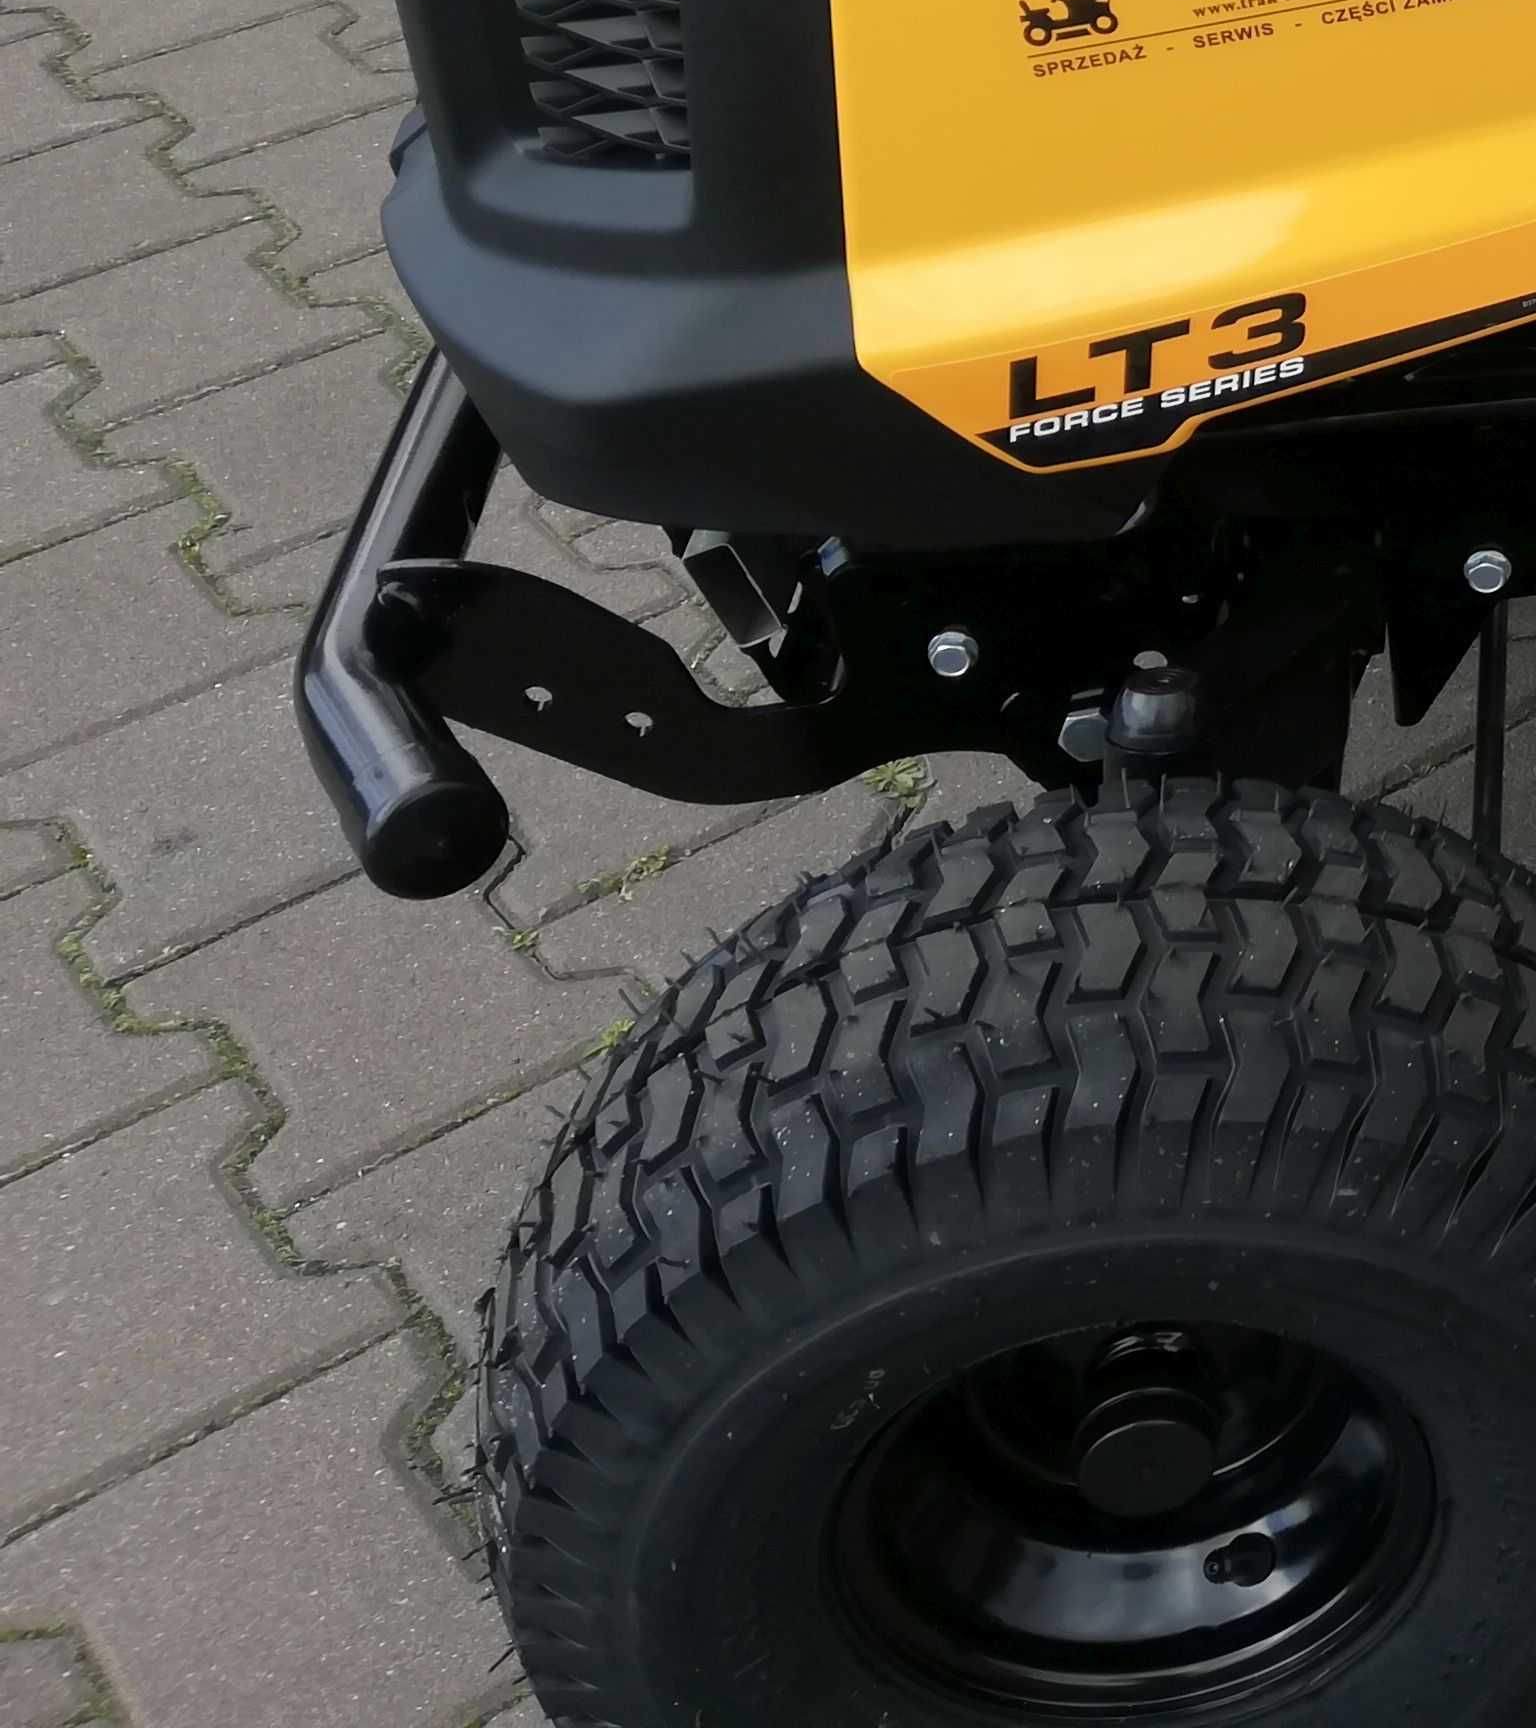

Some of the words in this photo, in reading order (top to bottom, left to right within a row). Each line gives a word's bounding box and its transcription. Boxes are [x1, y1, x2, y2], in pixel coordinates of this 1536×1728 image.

[1033, 43, 1148, 79] SPRZEDAŻ
[1192, 22, 1276, 50] SERWIS
[1009, 396, 1144, 443] FORCE
[1160, 356, 1305, 408] SERIES
